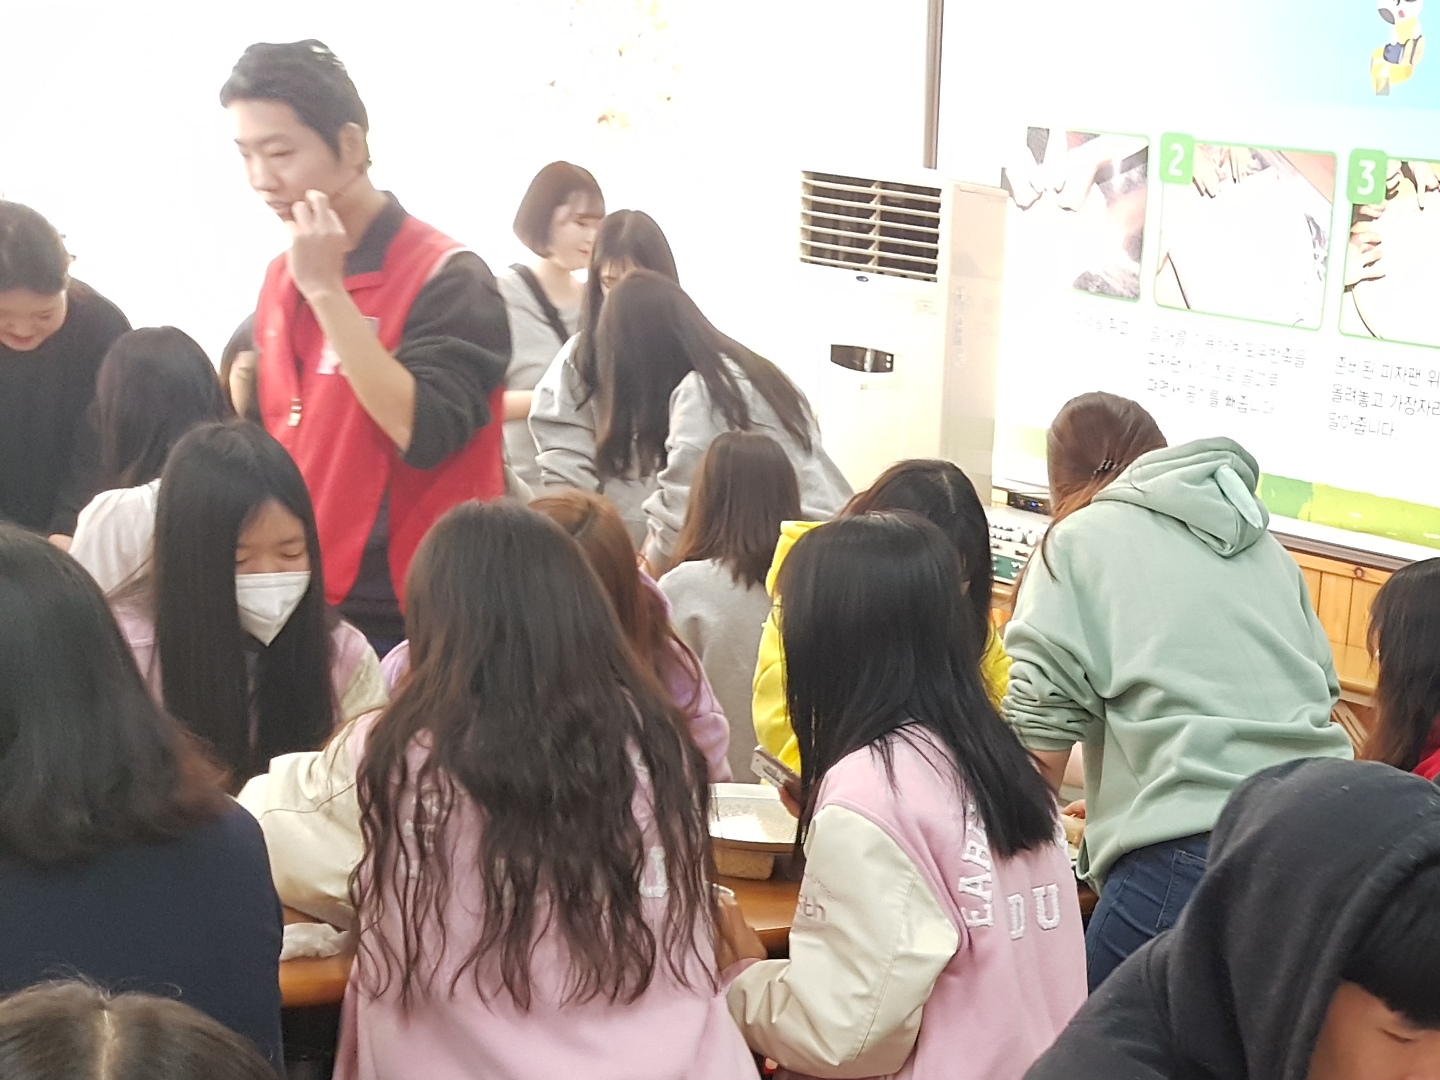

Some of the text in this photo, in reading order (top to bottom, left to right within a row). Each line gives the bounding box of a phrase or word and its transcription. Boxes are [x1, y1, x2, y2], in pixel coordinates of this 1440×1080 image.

[1167, 142, 1185, 176] 2
[1357, 160, 1376, 195] 3
[1335, 356, 1374, 380] 준비된
[1381, 363, 1421, 387] 피자팬
[1331, 383, 1384, 408] 올려놓고
